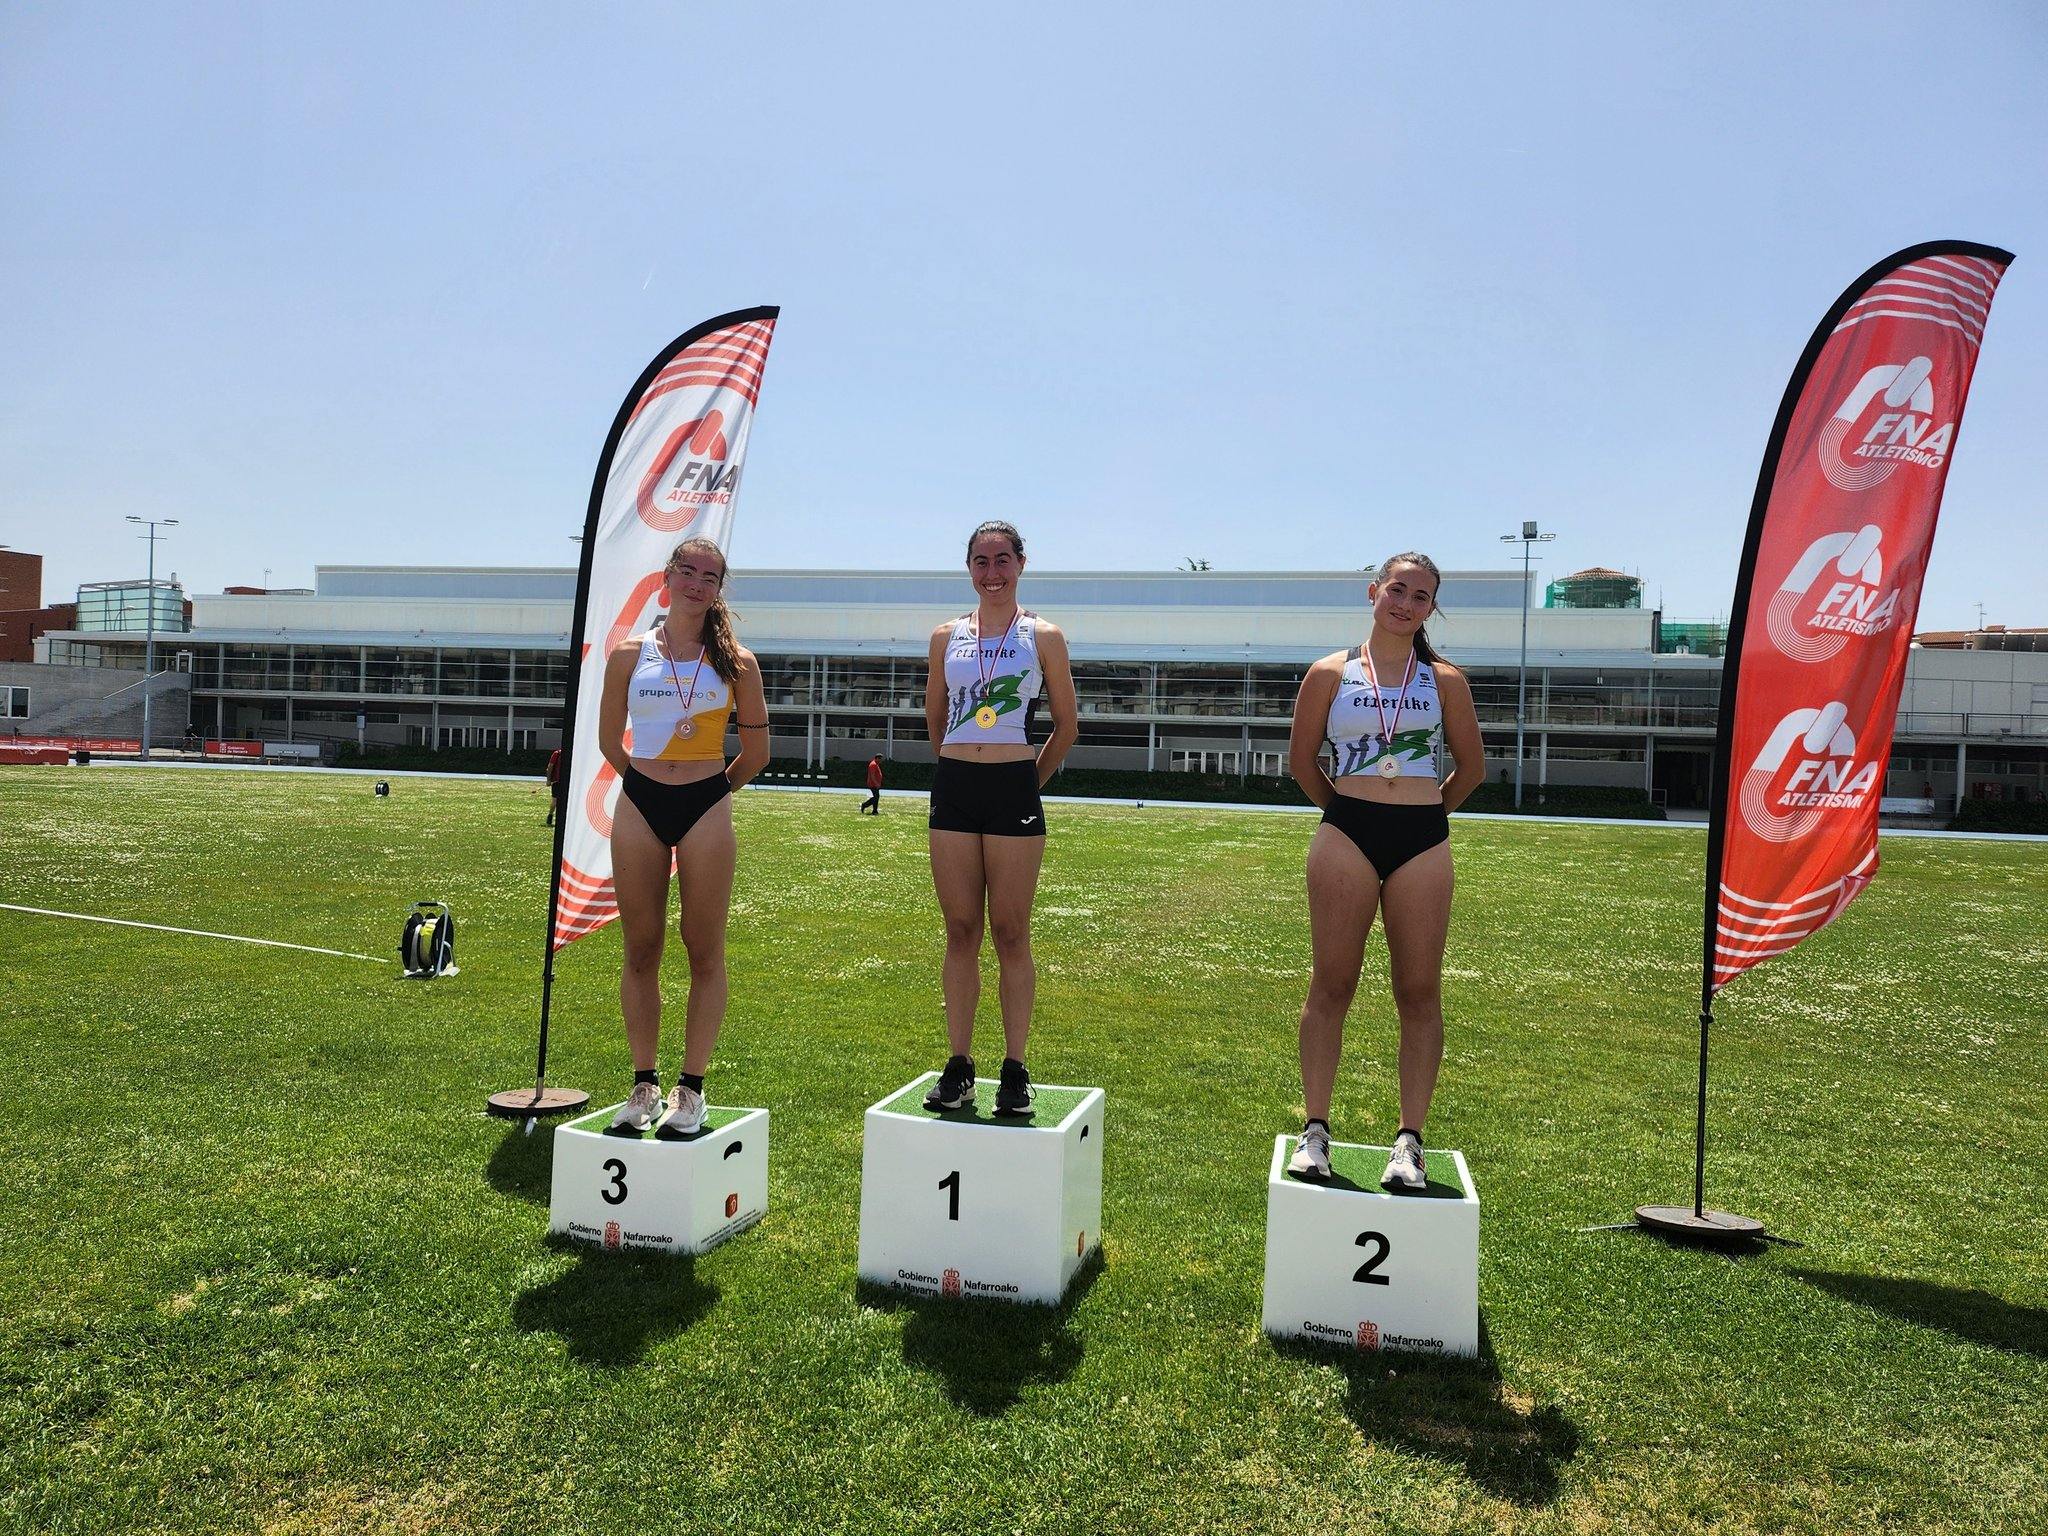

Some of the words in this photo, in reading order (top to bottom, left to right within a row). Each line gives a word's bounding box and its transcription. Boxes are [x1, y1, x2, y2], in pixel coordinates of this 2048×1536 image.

[1862, 413, 1954, 455] FNA
[1853, 443, 1945, 469] ATLETISMO
[673, 461, 739, 492] FNA
[666, 489, 732, 505] ATLETISMO
[1816, 582, 1900, 622] FNA
[1807, 613, 1891, 636] ATLETISMO
[639, 689, 704, 699] grupomoeo
[1784, 760, 1878, 793] FNA
[1777, 792, 1865, 808] ATLETISM
[601, 1158, 628, 1205] 3
[938, 1171, 960, 1221] 1
[568, 1221, 602, 1237] Gobierno
[623, 1231, 673, 1244] Nafarroako
[1352, 1231, 1391, 1286] 2
[898, 1269, 939, 1285] Gobierno
[903, 1281, 938, 1297] Navarra
[964, 1280, 1019, 1293] Nafarroako
[1303, 1321, 1353, 1338] Gobierno
[1382, 1333, 1444, 1348] Nafarroako
